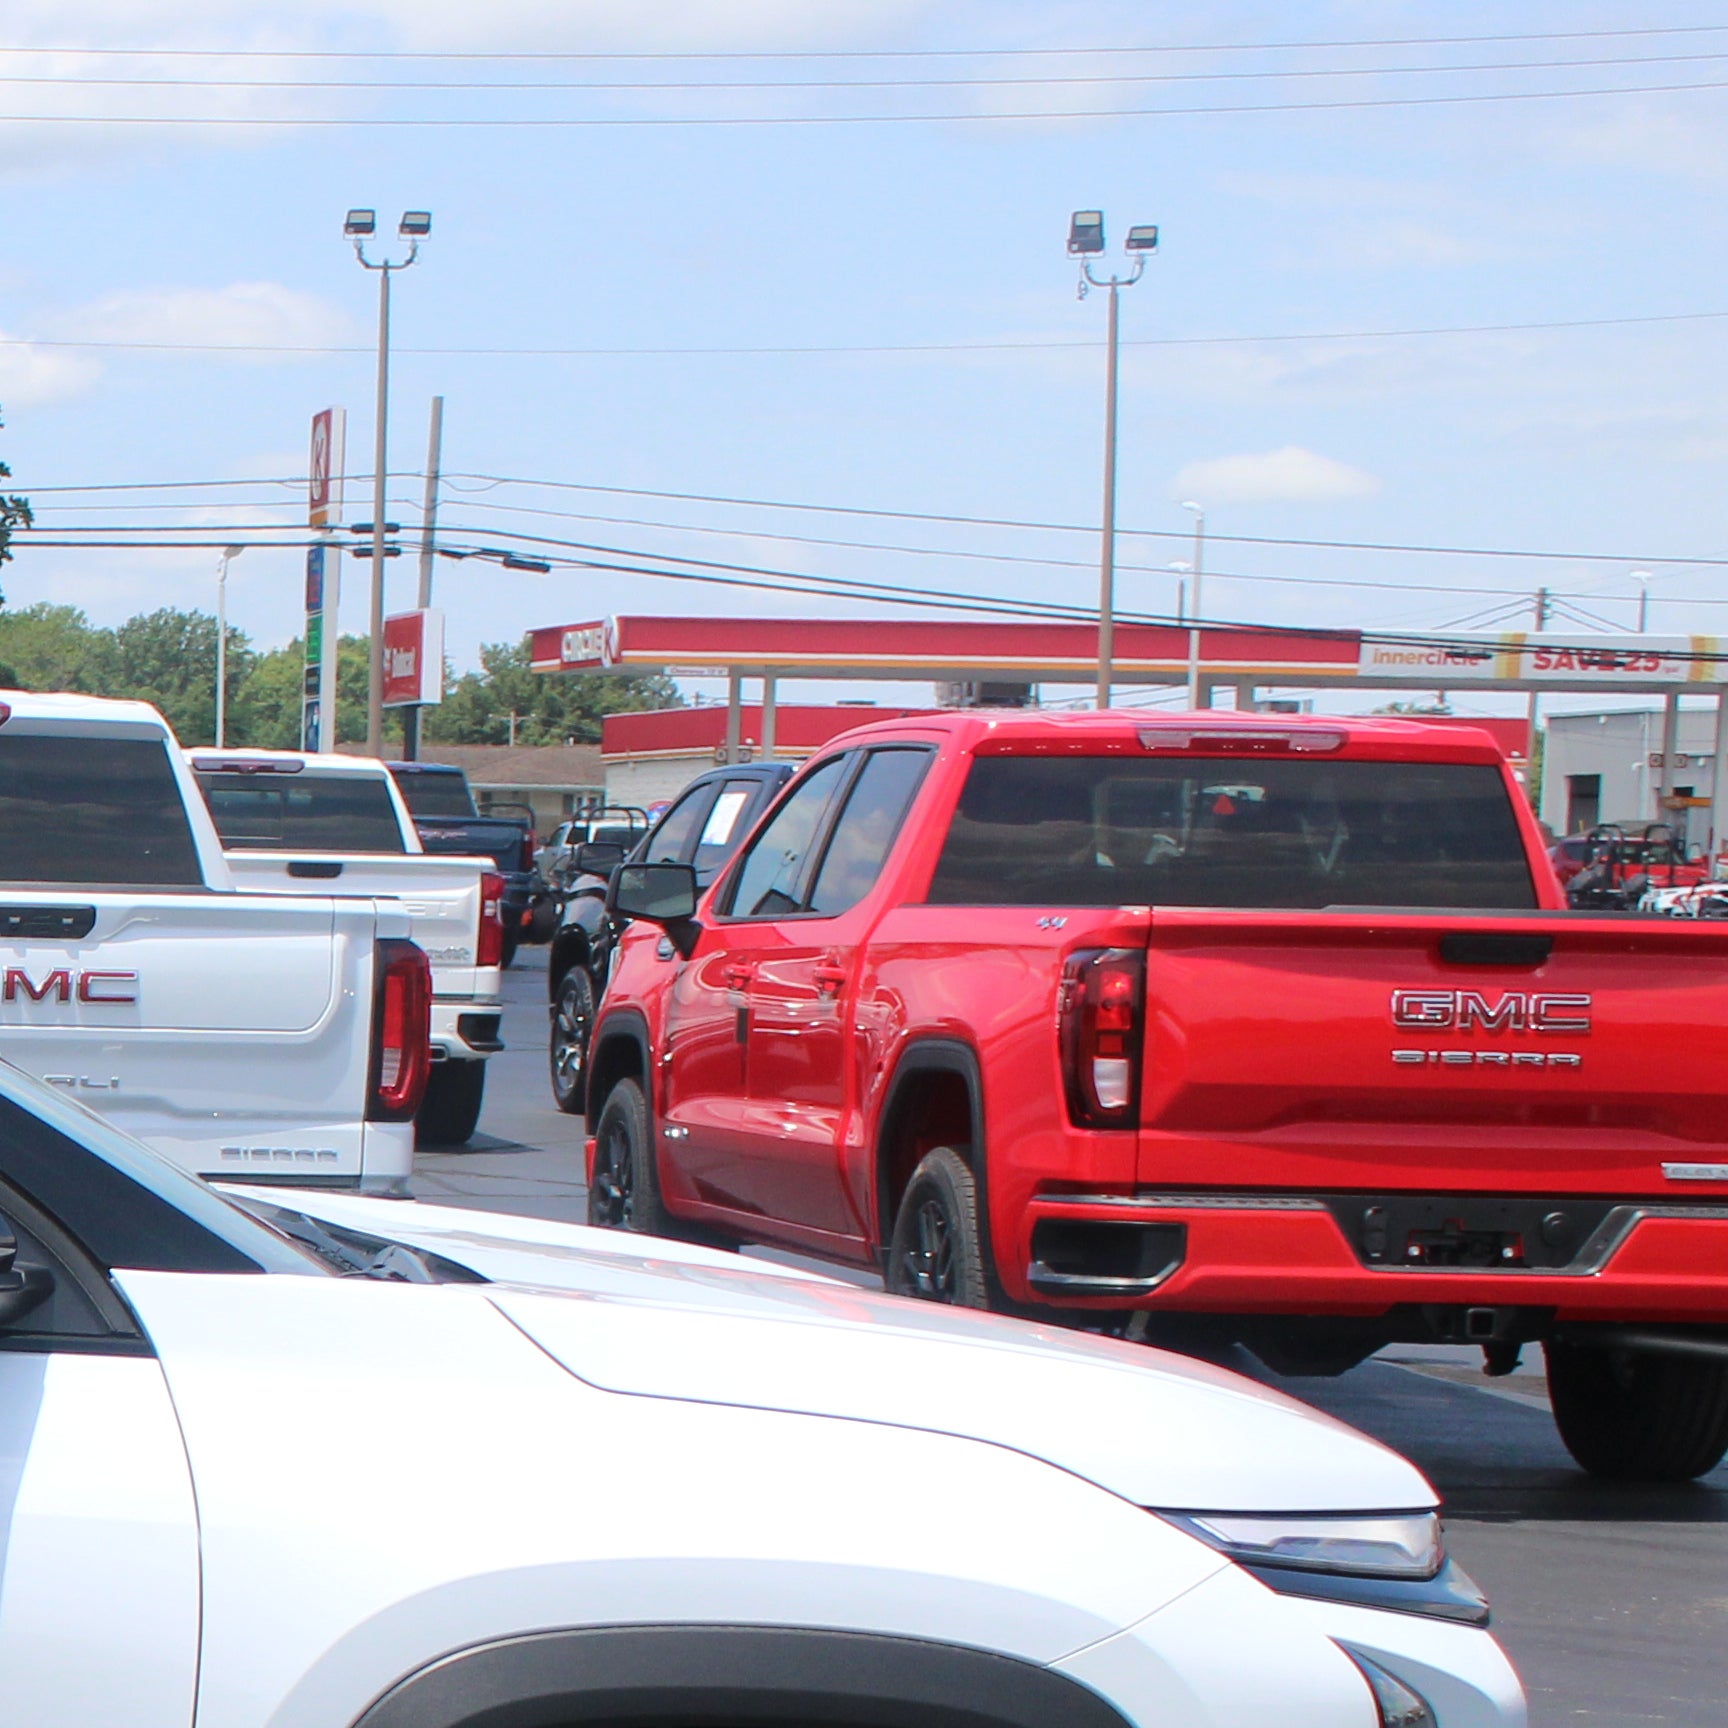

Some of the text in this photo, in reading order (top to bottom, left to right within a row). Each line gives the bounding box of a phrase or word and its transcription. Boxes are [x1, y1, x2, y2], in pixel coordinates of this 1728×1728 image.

[1391, 989, 1592, 1031] GMC
[1391, 1049, 1582, 1067] SIERRA
[220, 1147, 339, 1163] SIERRA
